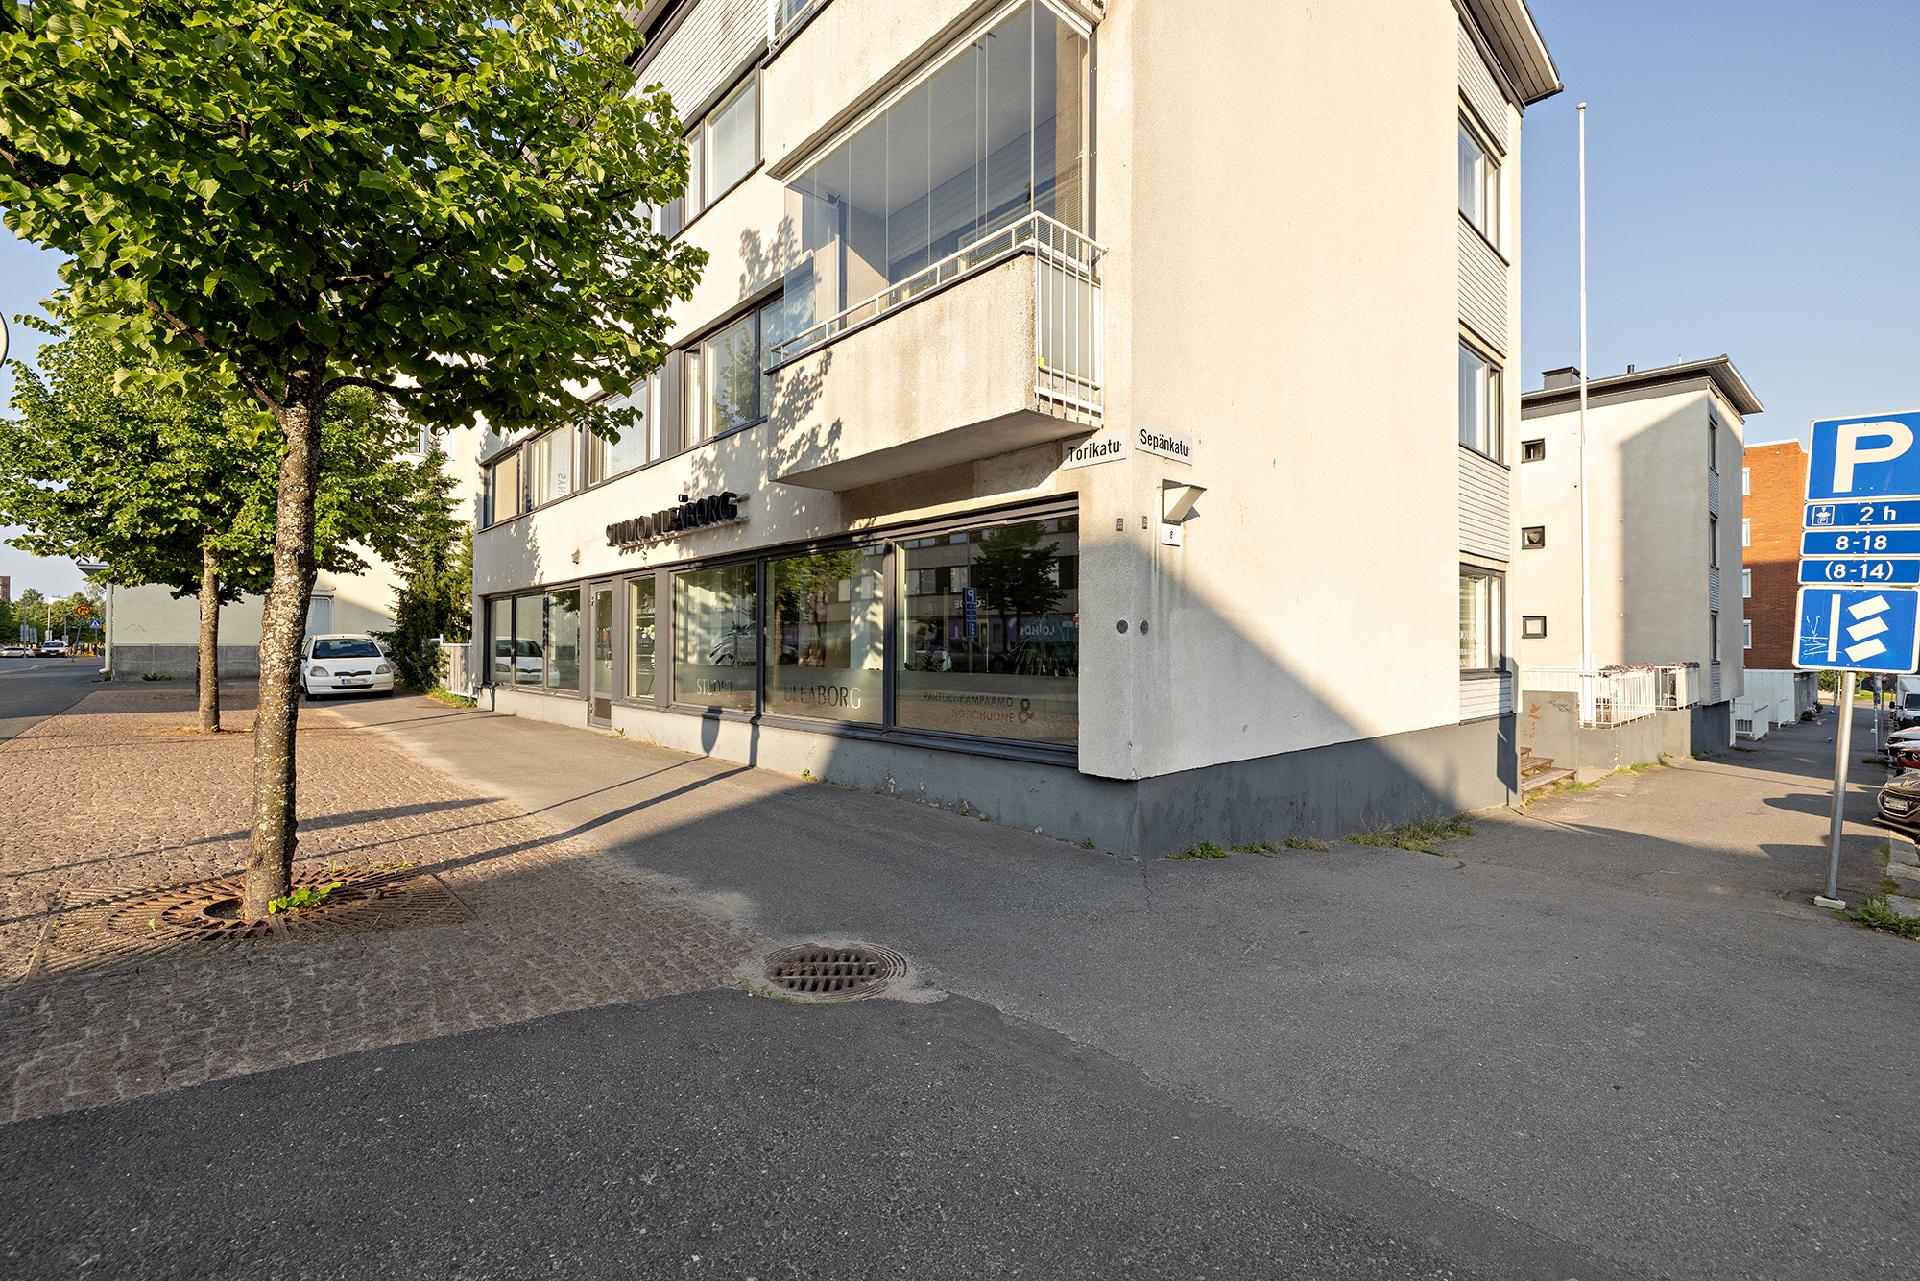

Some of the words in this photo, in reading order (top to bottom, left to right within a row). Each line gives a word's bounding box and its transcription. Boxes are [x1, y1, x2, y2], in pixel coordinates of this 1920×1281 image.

[1067, 440, 1120, 462] Torikatu
[1139, 428, 1189, 457] Sepänkatu
[1832, 421, 1914, 493] P
[1860, 506, 1874, 522] 2
[1883, 505, 1897, 521] h
[1835, 535, 1888, 551] 8-18
[1824, 560, 1894, 581] (8-14)
